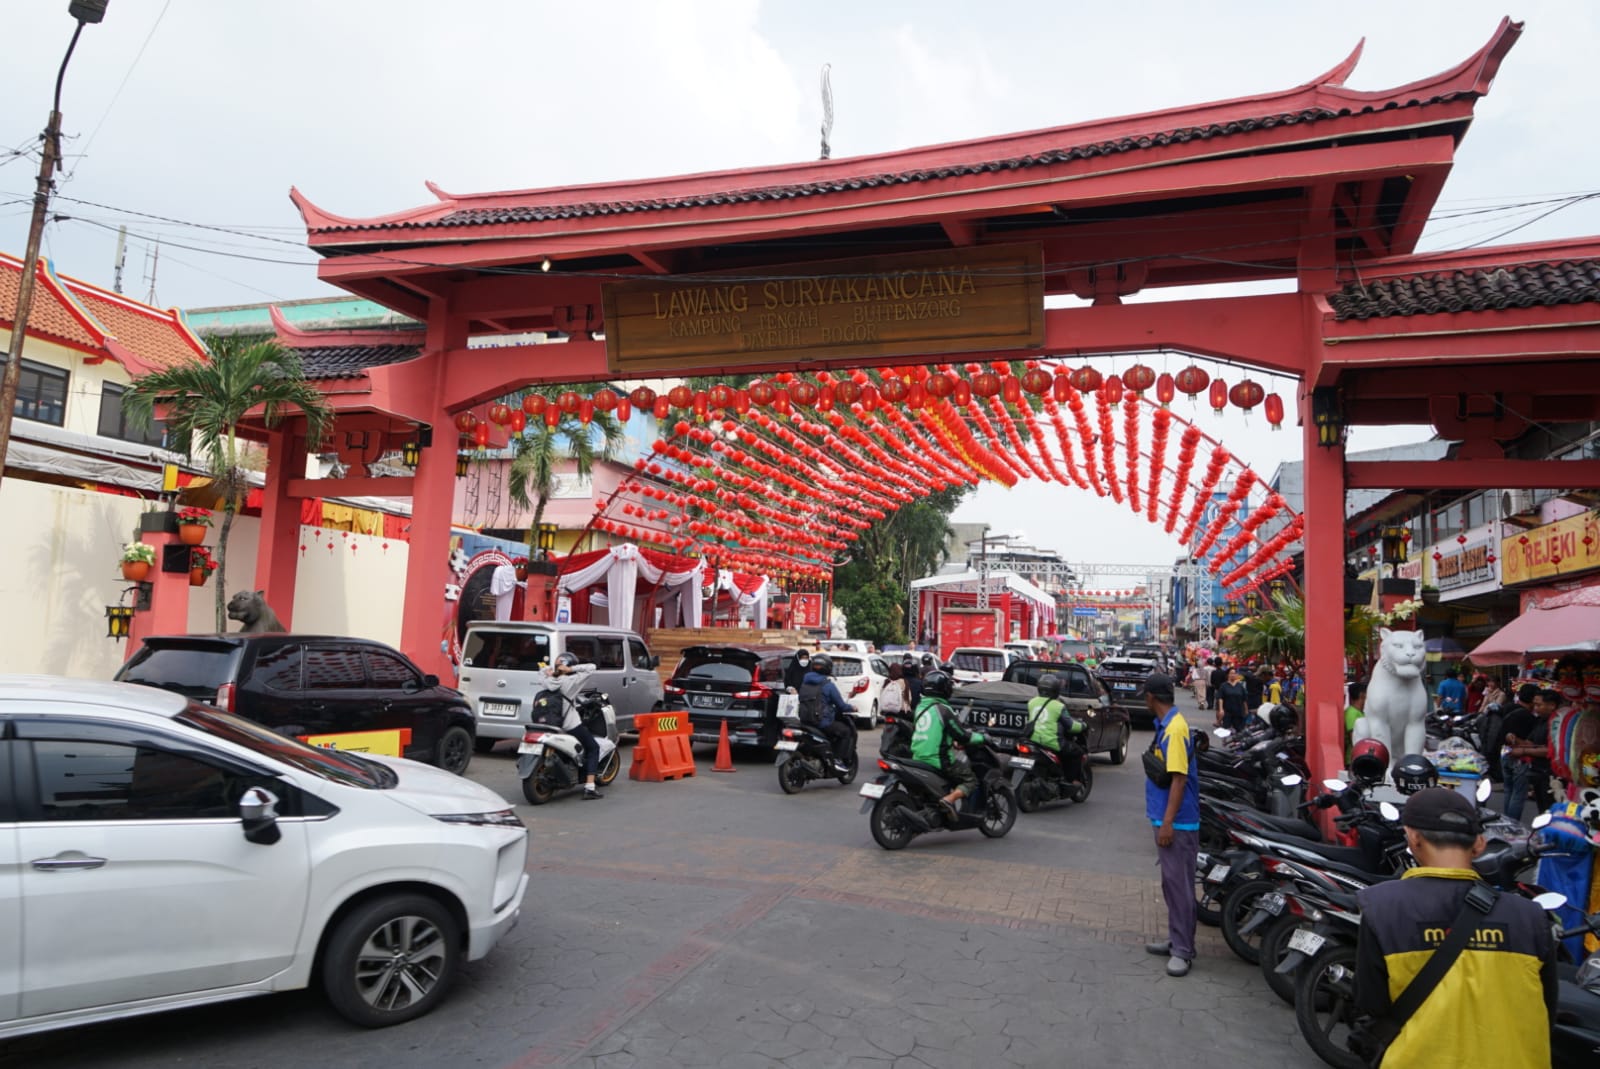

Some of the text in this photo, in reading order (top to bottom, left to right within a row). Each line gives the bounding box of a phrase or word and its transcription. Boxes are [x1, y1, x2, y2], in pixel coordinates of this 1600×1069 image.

[653, 265, 976, 320] LAWANG SURYAKANCANA
[669, 315, 741, 337] KAMPUNG
[759, 311, 819, 330] TENGAH
[821, 324, 878, 342] BOGOR
[1525, 531, 1576, 568] REJEKI
